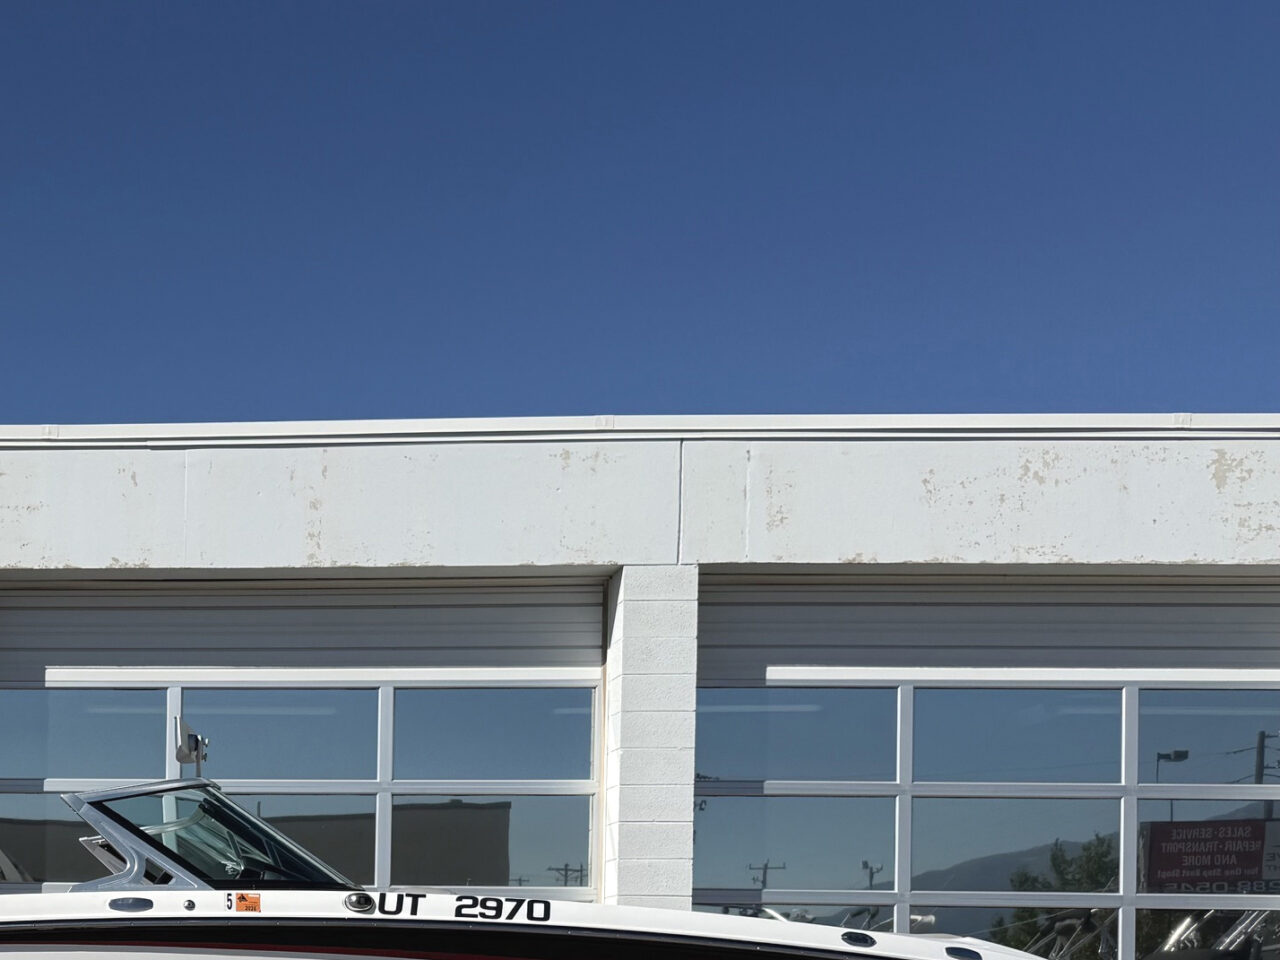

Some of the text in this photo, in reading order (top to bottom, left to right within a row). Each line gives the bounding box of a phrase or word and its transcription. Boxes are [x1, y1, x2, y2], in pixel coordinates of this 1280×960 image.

[226, 892, 233, 911] 5
[378, 892, 552, 922] UT 2970
